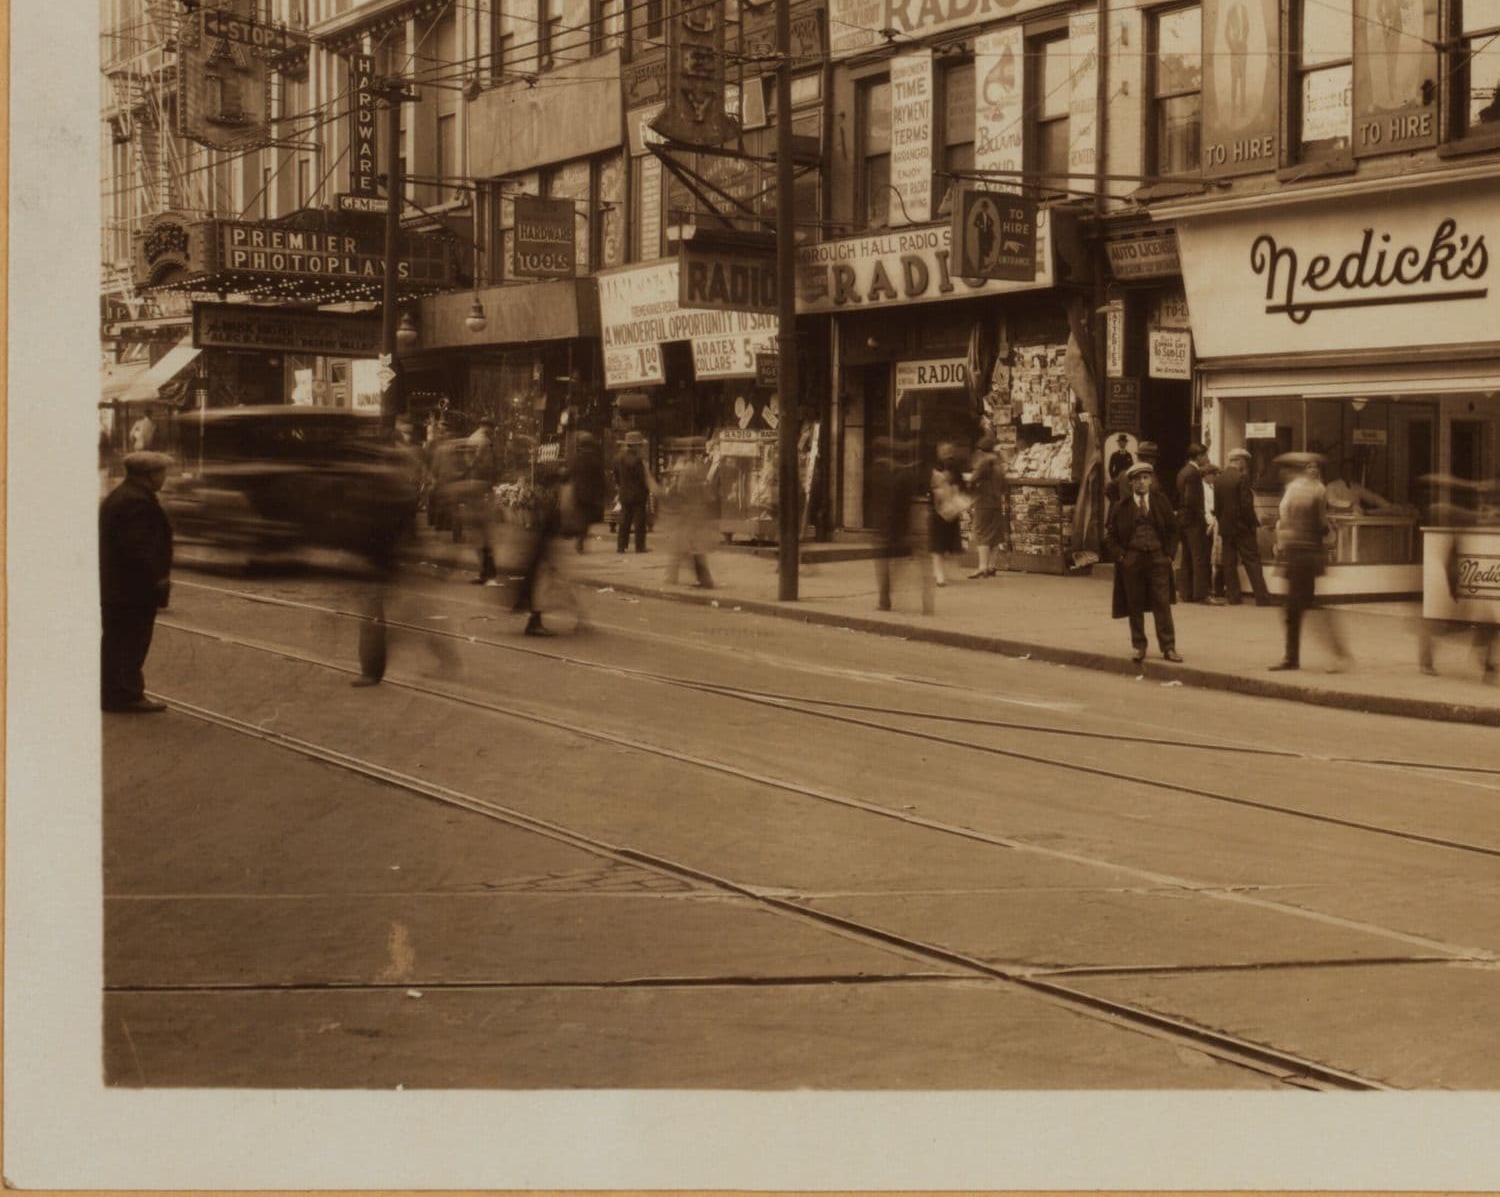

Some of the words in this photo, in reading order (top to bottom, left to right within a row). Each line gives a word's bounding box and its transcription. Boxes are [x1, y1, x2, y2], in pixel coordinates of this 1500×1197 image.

[227, 21, 276, 47] STOP
[894, 76, 928, 101] TIME
[892, 100, 931, 124] PAYMENT
[358, 59, 374, 190] HARDWARE
[893, 125, 929, 146] TERMS
[1359, 120, 1382, 146] TO
[1390, 113, 1433, 141] HIRE
[1205, 143, 1228, 168] TO
[1233, 134, 1275, 162] HIRE
[1008, 208, 1025, 221] TO
[518, 222, 573, 245] HARDWARE
[1002, 222, 1031, 235] HIRE
[233, 229, 357, 253] PREMIER
[800, 246, 857, 265] OROUGH
[860, 240, 898, 261] HALL
[899, 230, 938, 252] RADIO
[1111, 244, 1138, 261] AUTO
[517, 252, 570, 271] TOOLS
[1249, 215, 1489, 324] Nedick's
[832, 250, 990, 305] RADI
[604, 325, 613, 347] A
[613, 315, 668, 346] WONDERFUL
[668, 308, 734, 339] OPPORTUNITY
[695, 338, 737, 356] ARATEX
[916, 362, 967, 385] RADIO
